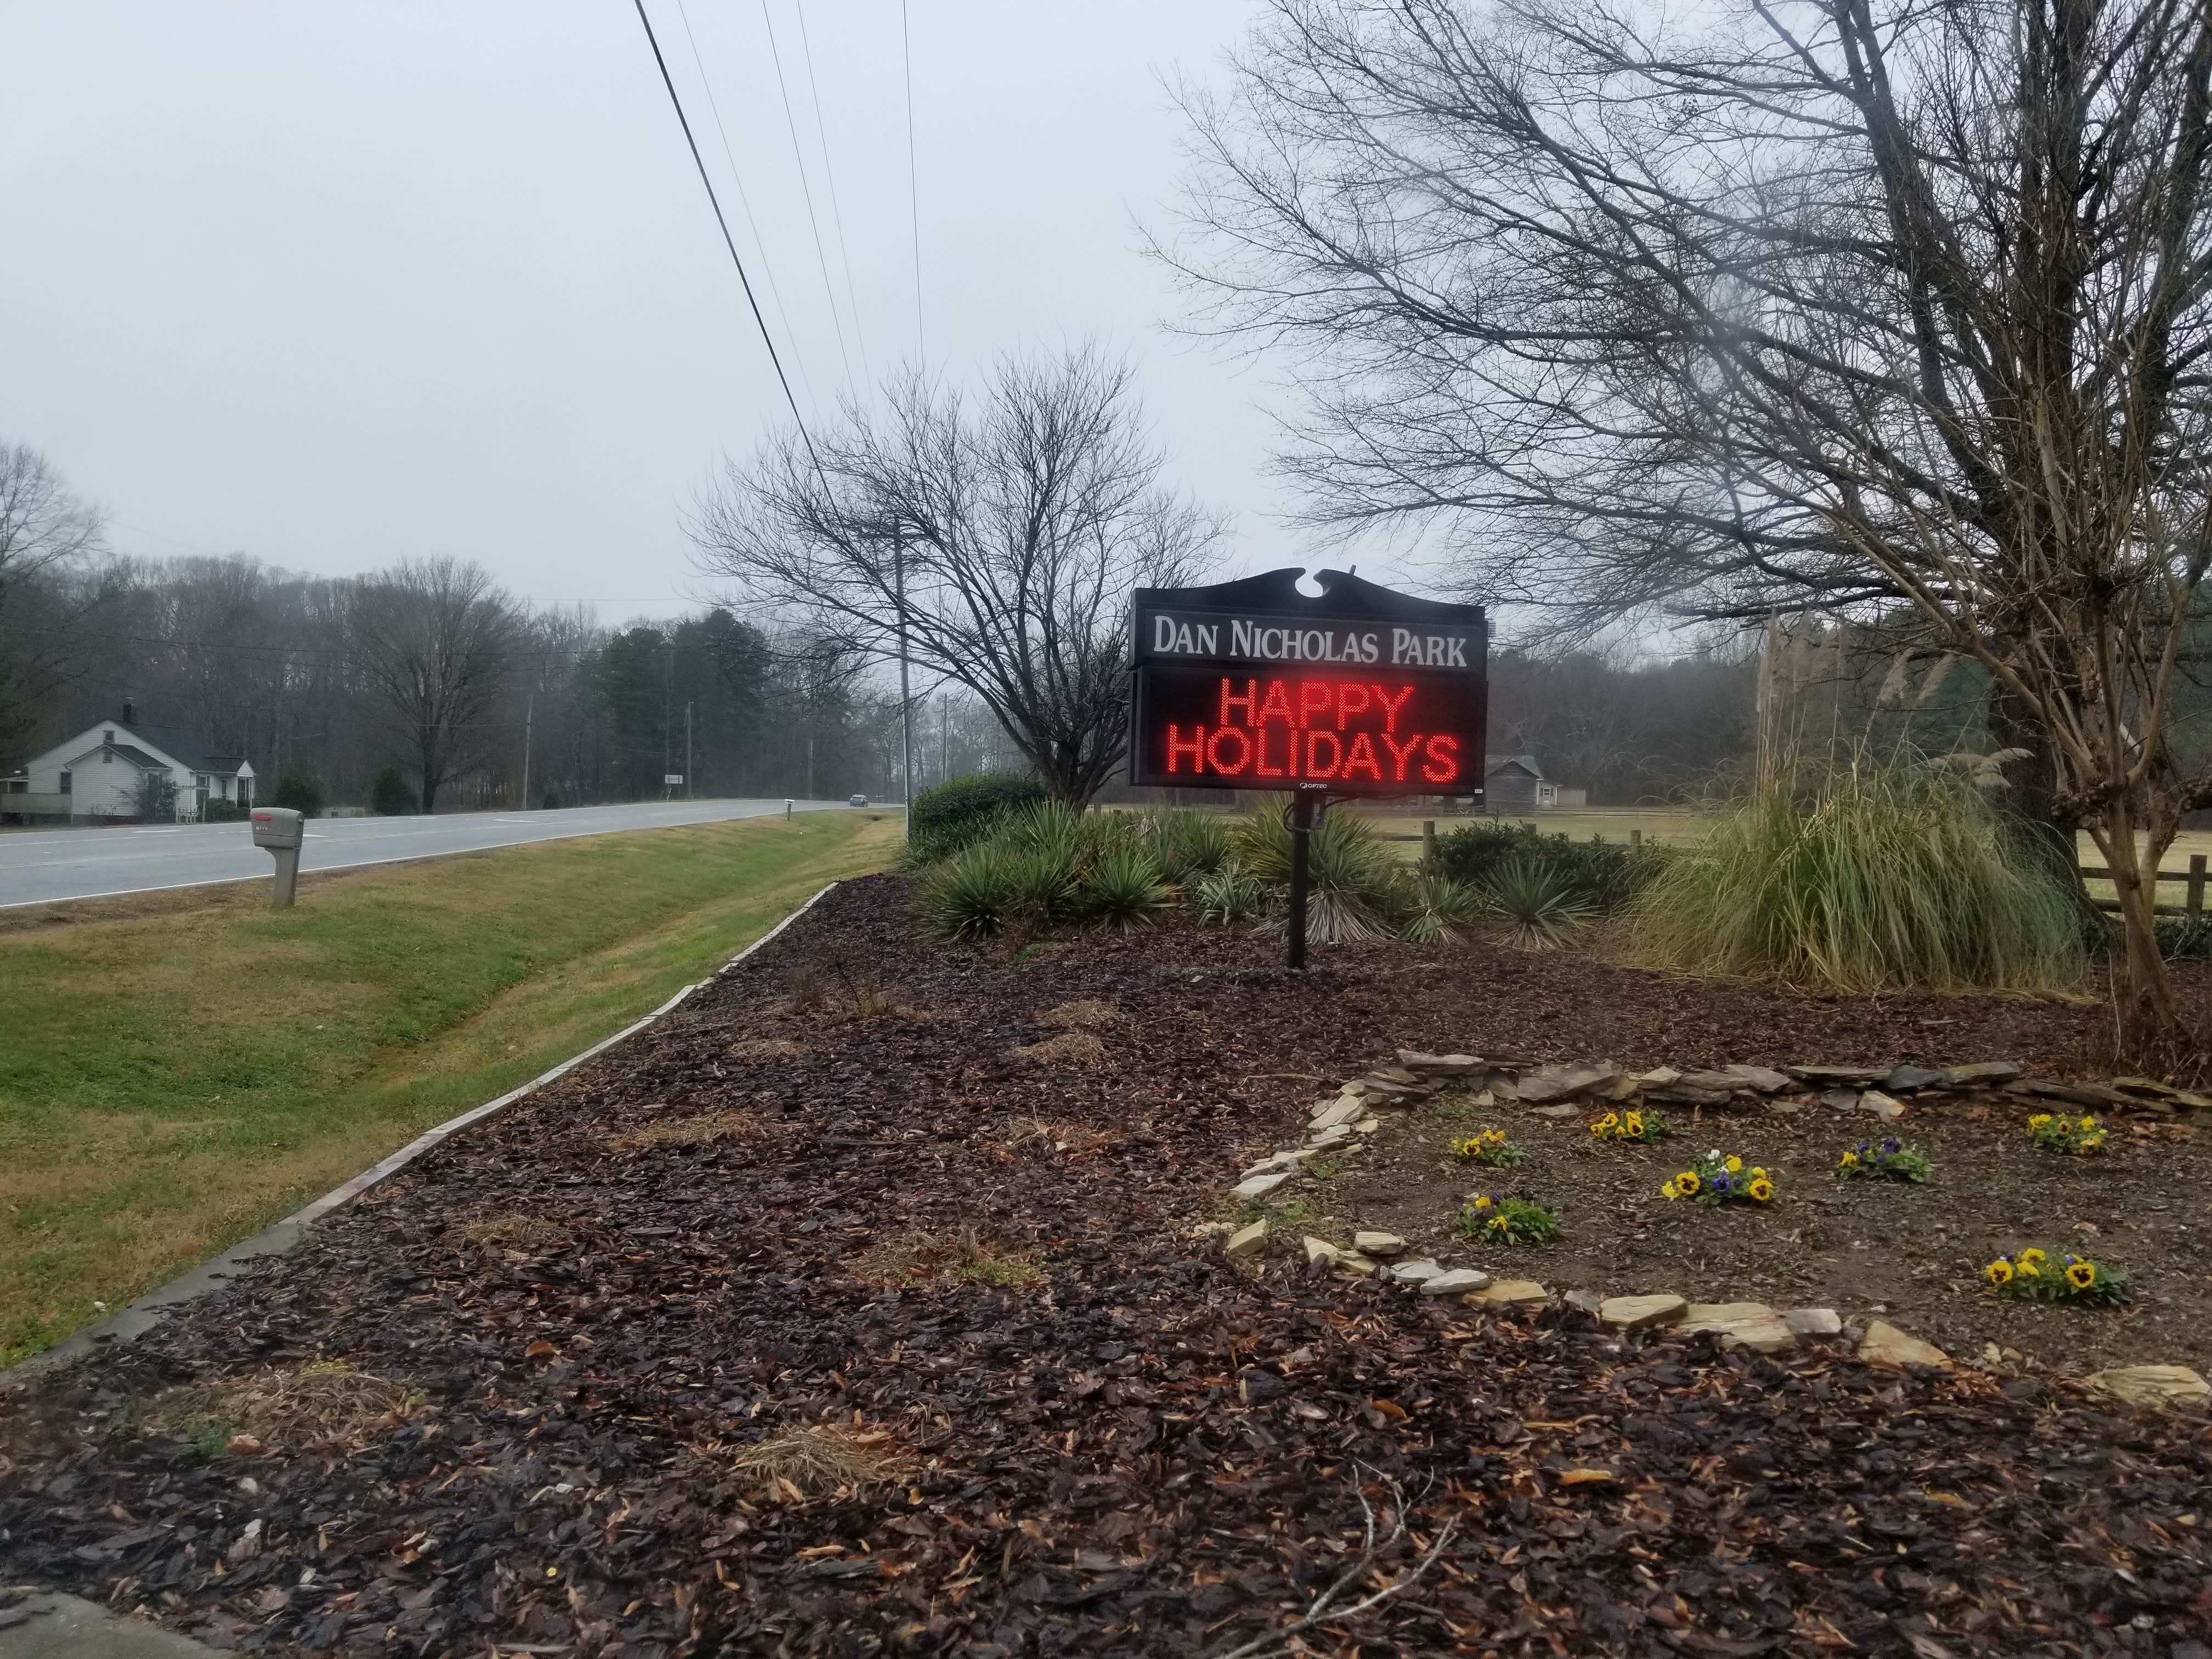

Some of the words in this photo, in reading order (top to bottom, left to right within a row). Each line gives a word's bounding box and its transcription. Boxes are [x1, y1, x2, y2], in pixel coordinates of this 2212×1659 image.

[1154, 615, 1218, 655] DAN
[1229, 620, 1379, 663] NICHOLAS
[1391, 628, 1467, 667] PARK
[1220, 677, 1415, 732] HAPPY
[1168, 724, 1458, 782] HOLIDAYS
